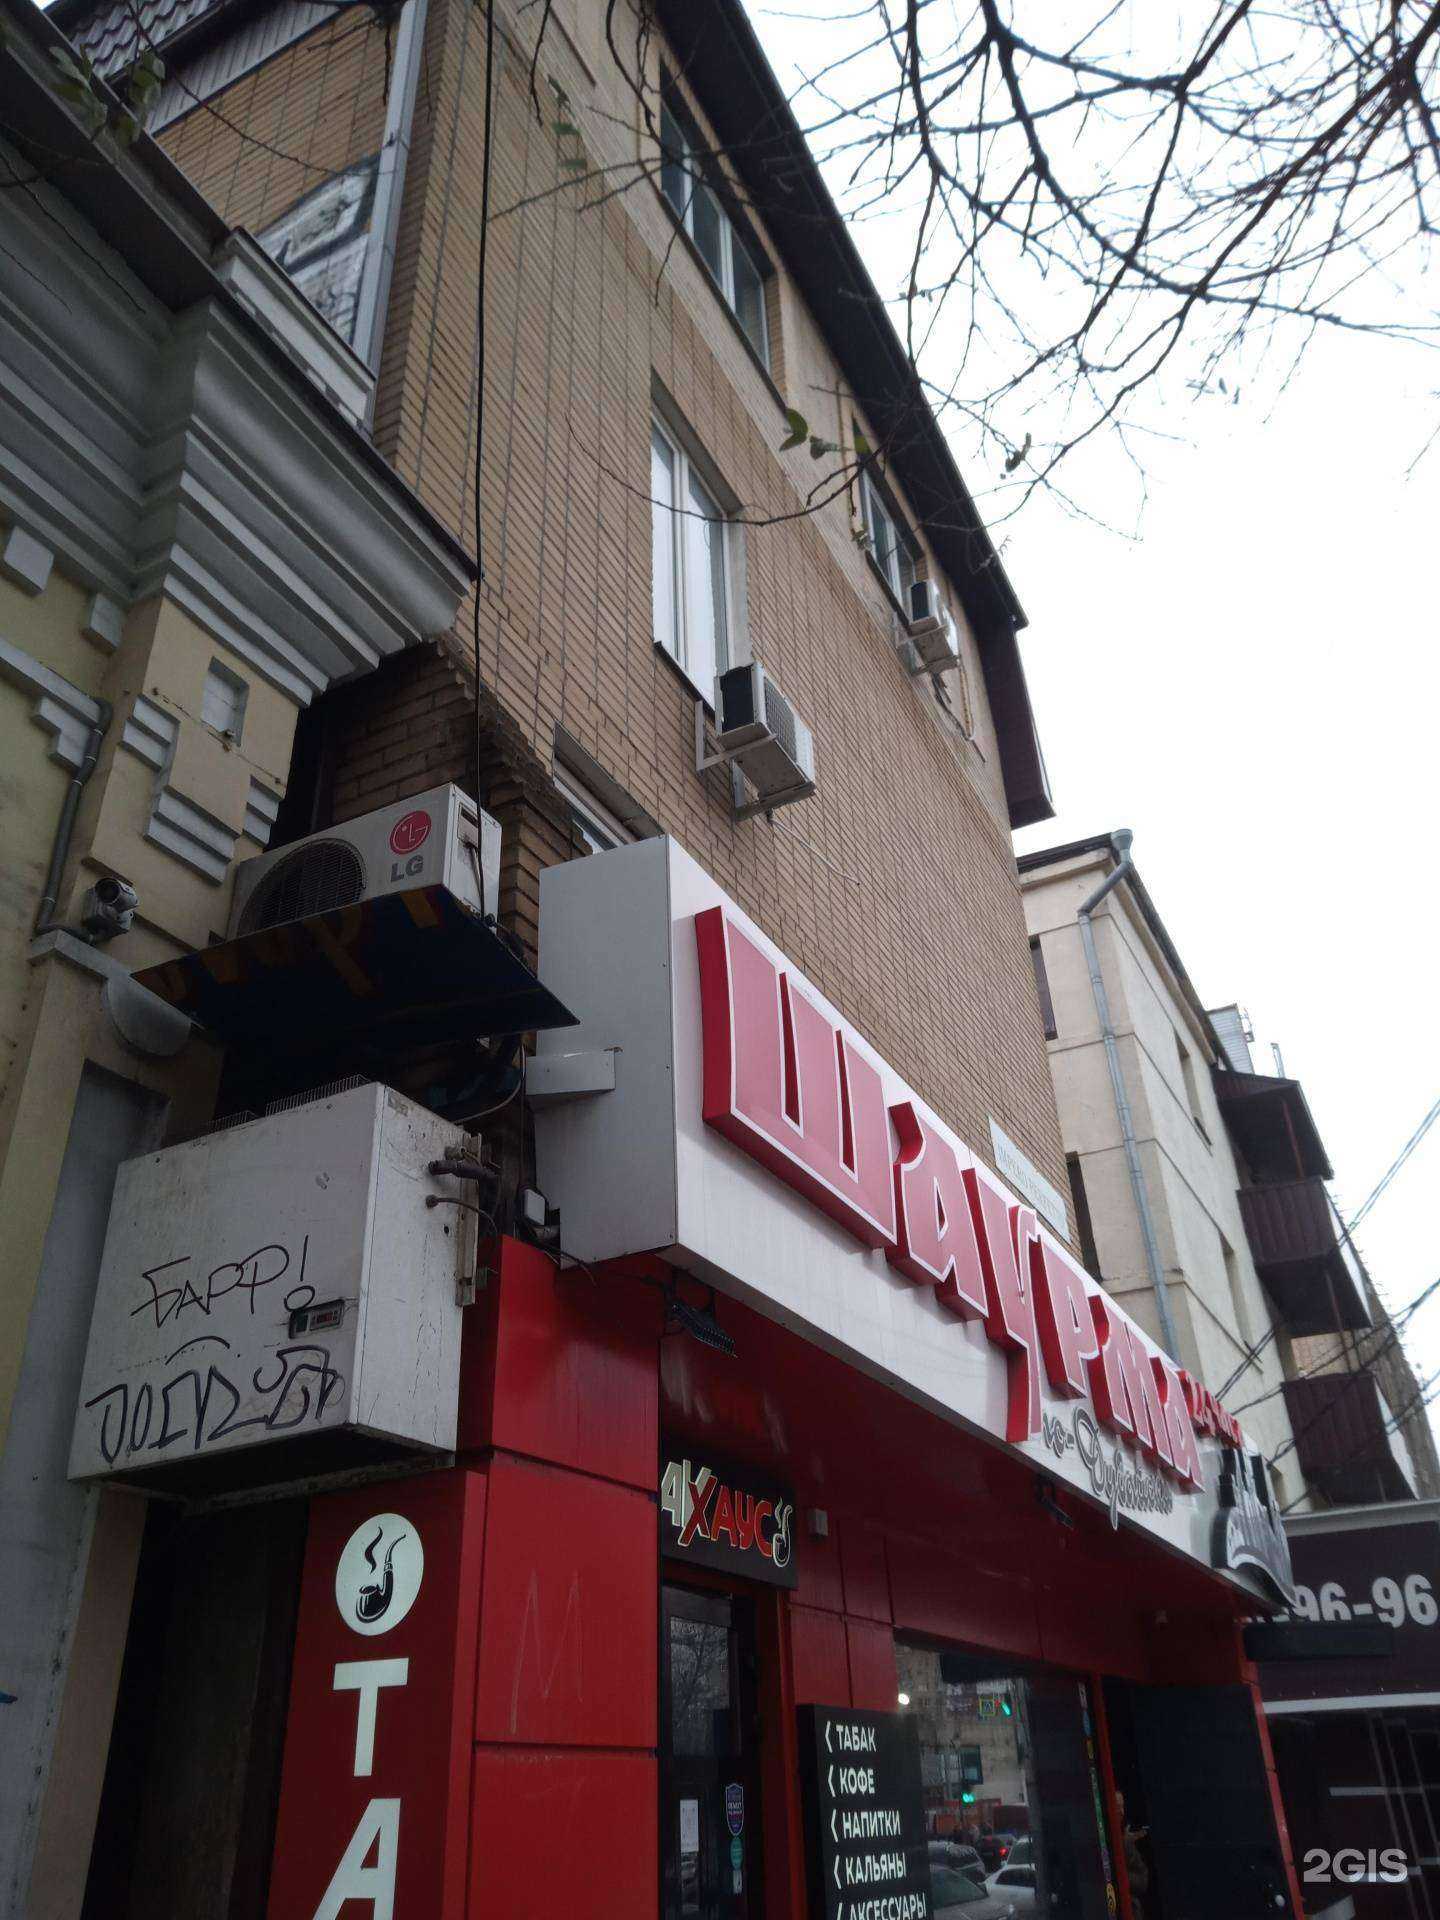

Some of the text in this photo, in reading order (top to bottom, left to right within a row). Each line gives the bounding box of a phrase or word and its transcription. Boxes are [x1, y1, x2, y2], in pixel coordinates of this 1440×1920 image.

[391, 854, 424, 883] LG
[695, 905, 1205, 1492] ШАУРМА
[678, 1475, 773, 1558] ХАУС
[835, 1724, 877, 1752] ТАБАК
[839, 1767, 876, 1795] КОФЕ
[842, 1810, 901, 1839] НАПИТКИ
[845, 1852, 907, 1885] КАЛЬЯНЫ
[849, 1892, 927, 1920] АКСЕССУАРЫ
